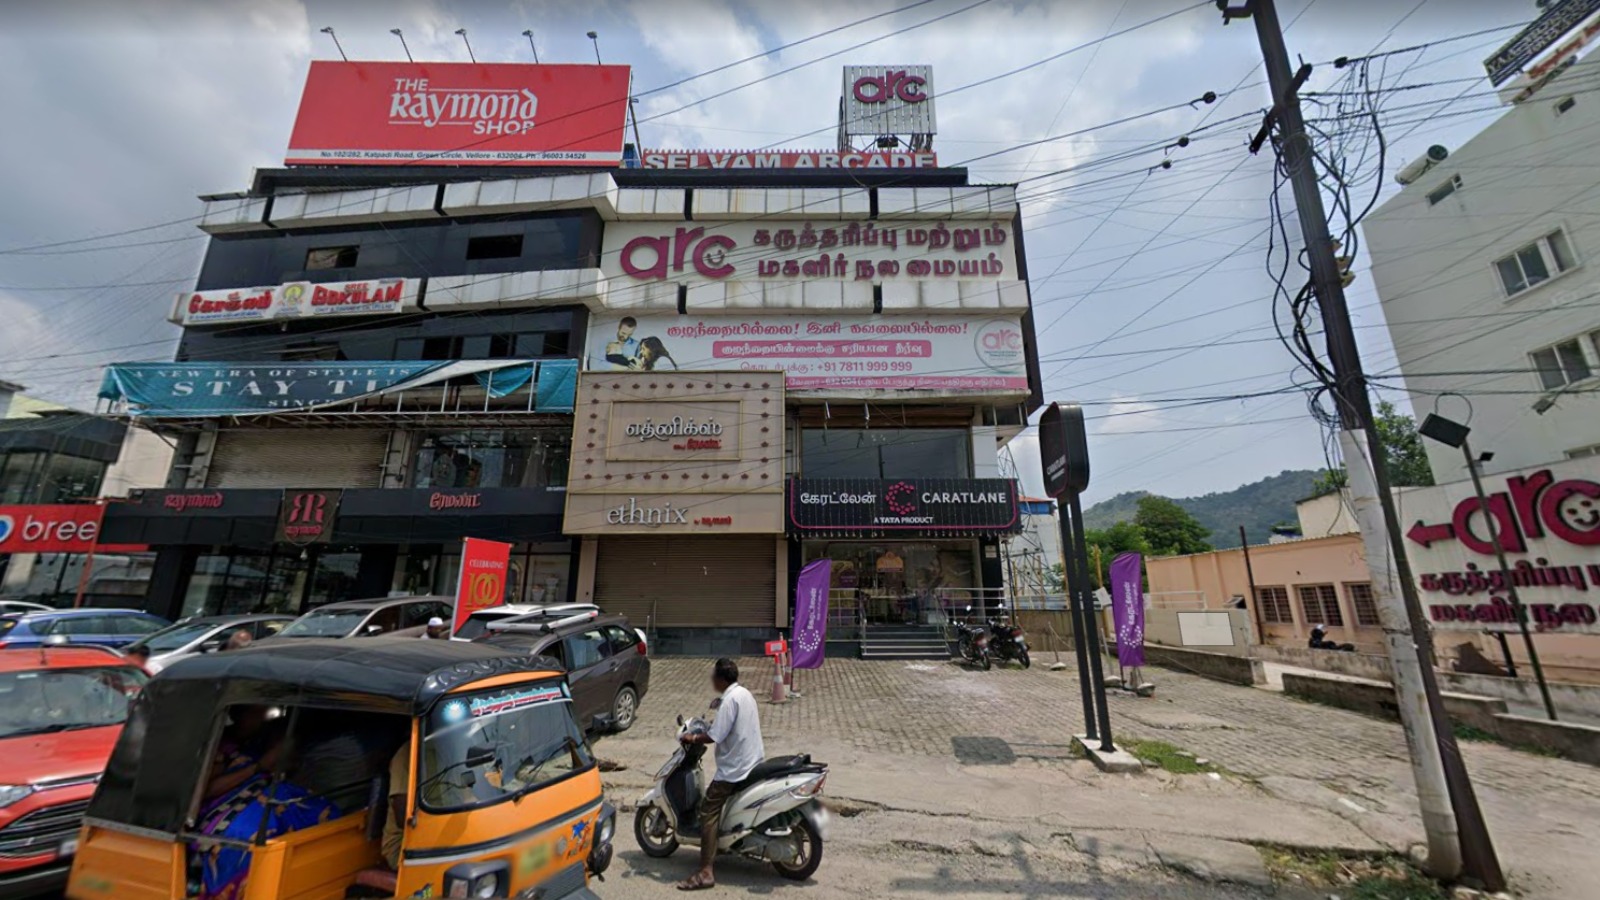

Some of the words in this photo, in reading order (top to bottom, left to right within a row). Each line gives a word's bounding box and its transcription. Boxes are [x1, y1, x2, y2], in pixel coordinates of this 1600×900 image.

[395, 78, 428, 91] THE
[853, 70, 927, 104] arc
[390, 89, 538, 127] Raymond
[473, 120, 535, 135] SHOP
[644, 153, 782, 169] SELVAM
[795, 153, 935, 169] ARCADE
[754, 221, 897, 251] கருத்தரிப்பு
[906, 221, 1006, 251] மற்றும்
[620, 226, 737, 280] arc
[758, 252, 849, 278] மகளிர்
[982, 329, 1020, 350] arc
[215, 369, 257, 377] ERA
[390, 368, 410, 376] IS
[817, 362, 836, 372] +91
[840, 362, 864, 372] 7811
[867, 361, 888, 372] 999
[890, 361, 912, 372] 999
[172, 380, 297, 397] STAY
[800, 492, 877, 506] கேரட்லேன்
[922, 492, 1006, 503] CARATLANE
[607, 498, 689, 526] ethnix
[1452, 469, 1600, 556] arc
